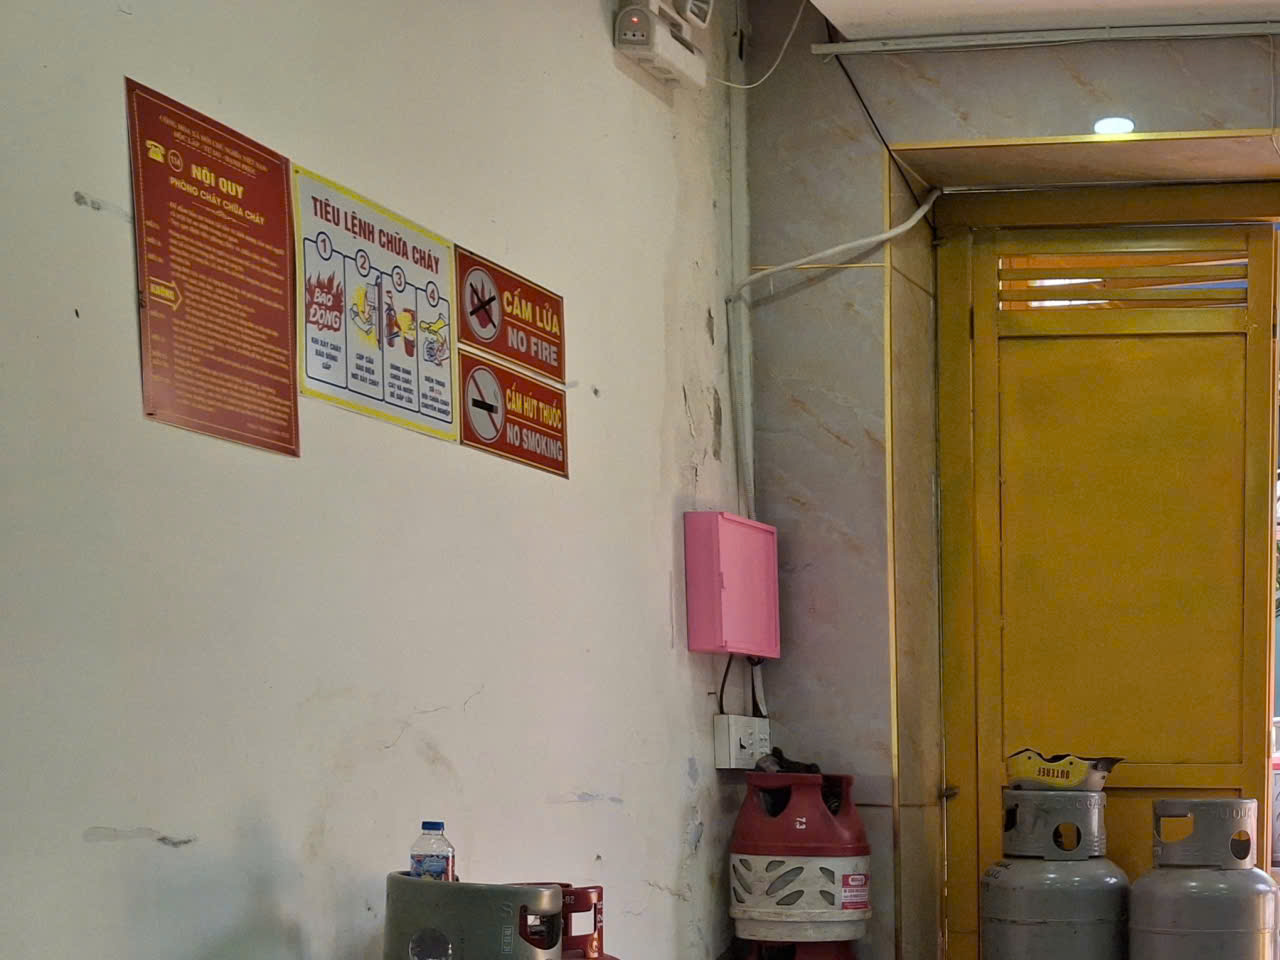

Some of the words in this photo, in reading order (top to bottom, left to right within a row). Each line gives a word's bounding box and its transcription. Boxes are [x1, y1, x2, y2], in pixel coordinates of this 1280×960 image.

[169, 176, 199, 197] PHÒNG
[191, 162, 216, 188] NỘI
[218, 177, 244, 199] QUY
[311, 195, 341, 227] TIÊU
[344, 211, 375, 244] LỆNH
[378, 229, 409, 261] CHỮA
[412, 245, 440, 275] CHÁY
[319, 238, 328, 254] 1
[359, 254, 367, 271] 2
[395, 271, 403, 288] 3
[503, 288, 533, 323] CẤM
[536, 302, 561, 337] LỬA
[507, 326, 528, 353] NO
[530, 336, 559, 367] FIRE
[506, 382, 523, 412] CẤM
[523, 392, 538, 419] HÚT
[539, 398, 562, 429] THUỐC
[506, 423, 521, 447] NO
[521, 426, 563, 462] SMOKING
